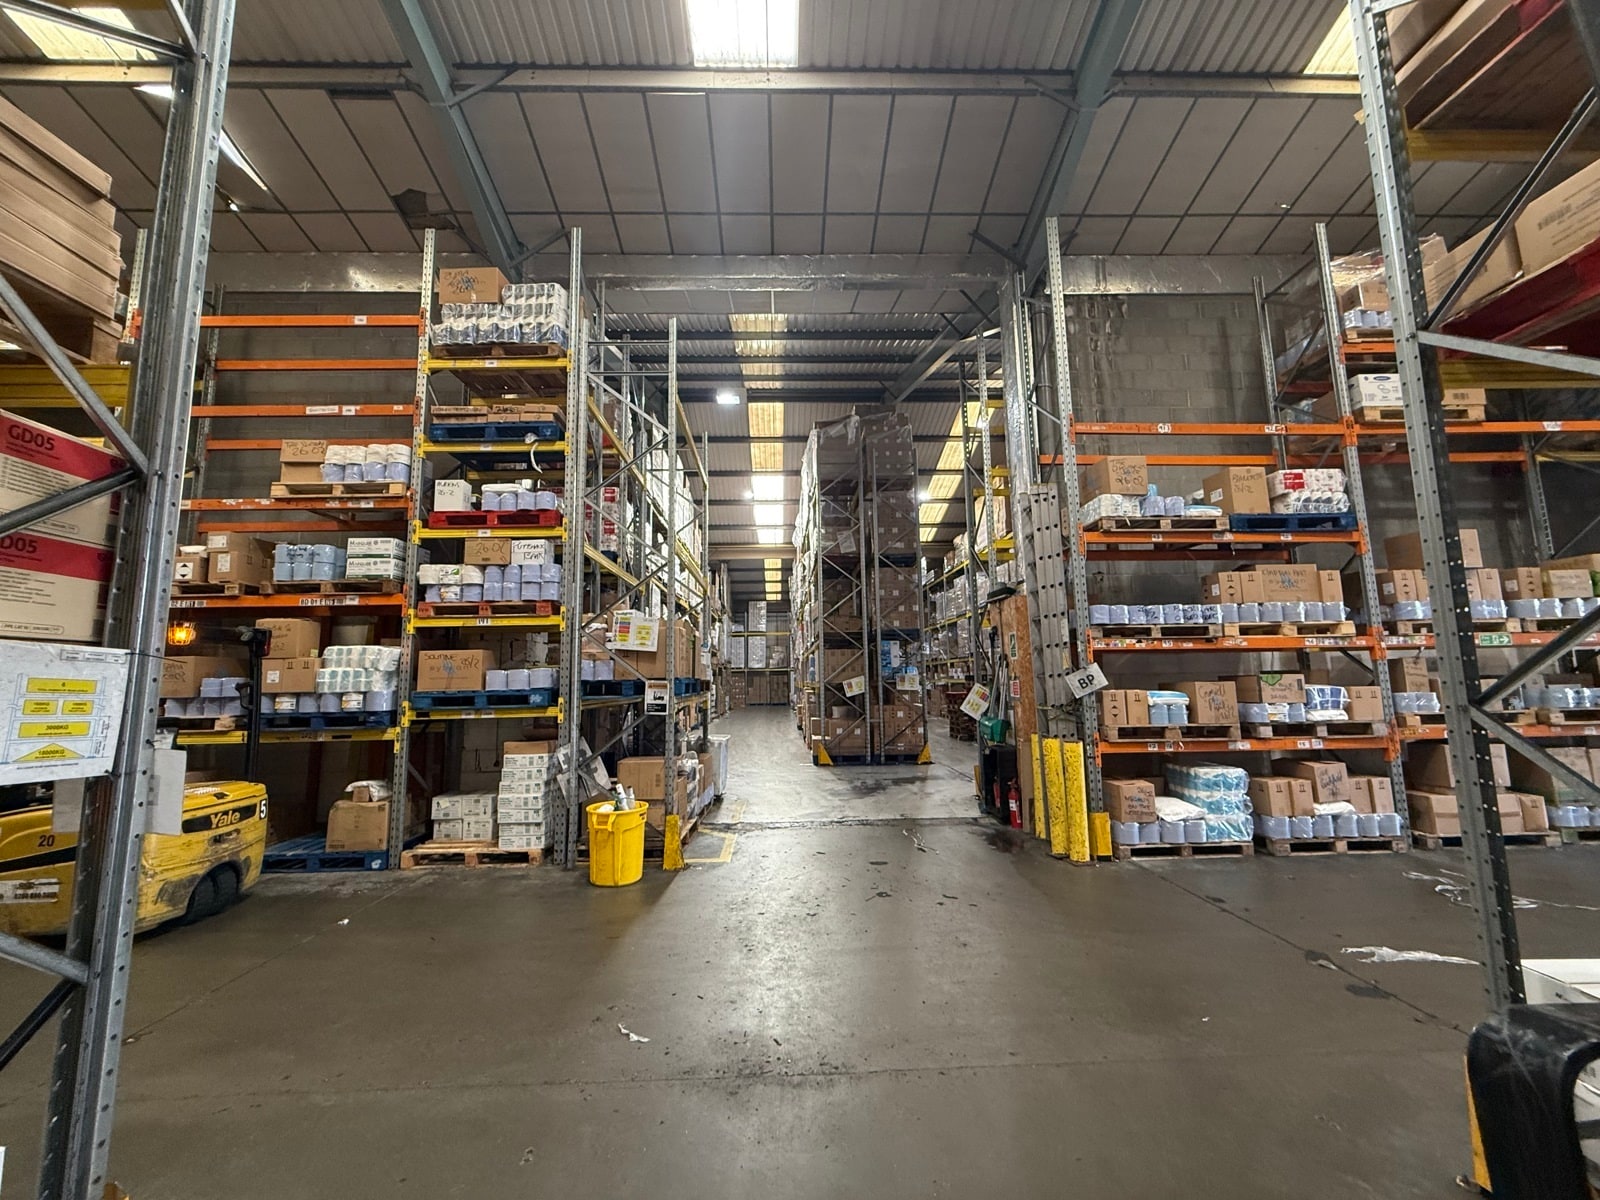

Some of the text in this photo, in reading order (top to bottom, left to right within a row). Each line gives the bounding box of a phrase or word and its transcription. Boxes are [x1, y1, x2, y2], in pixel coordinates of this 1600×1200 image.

[8, 424, 56, 451] GD05
[0, 535, 38, 554] D05
[1077, 674, 1095, 690] BP
[260, 800, 267, 819] 5
[210, 810, 240, 829] Yale
[38, 834, 54, 848] 20
